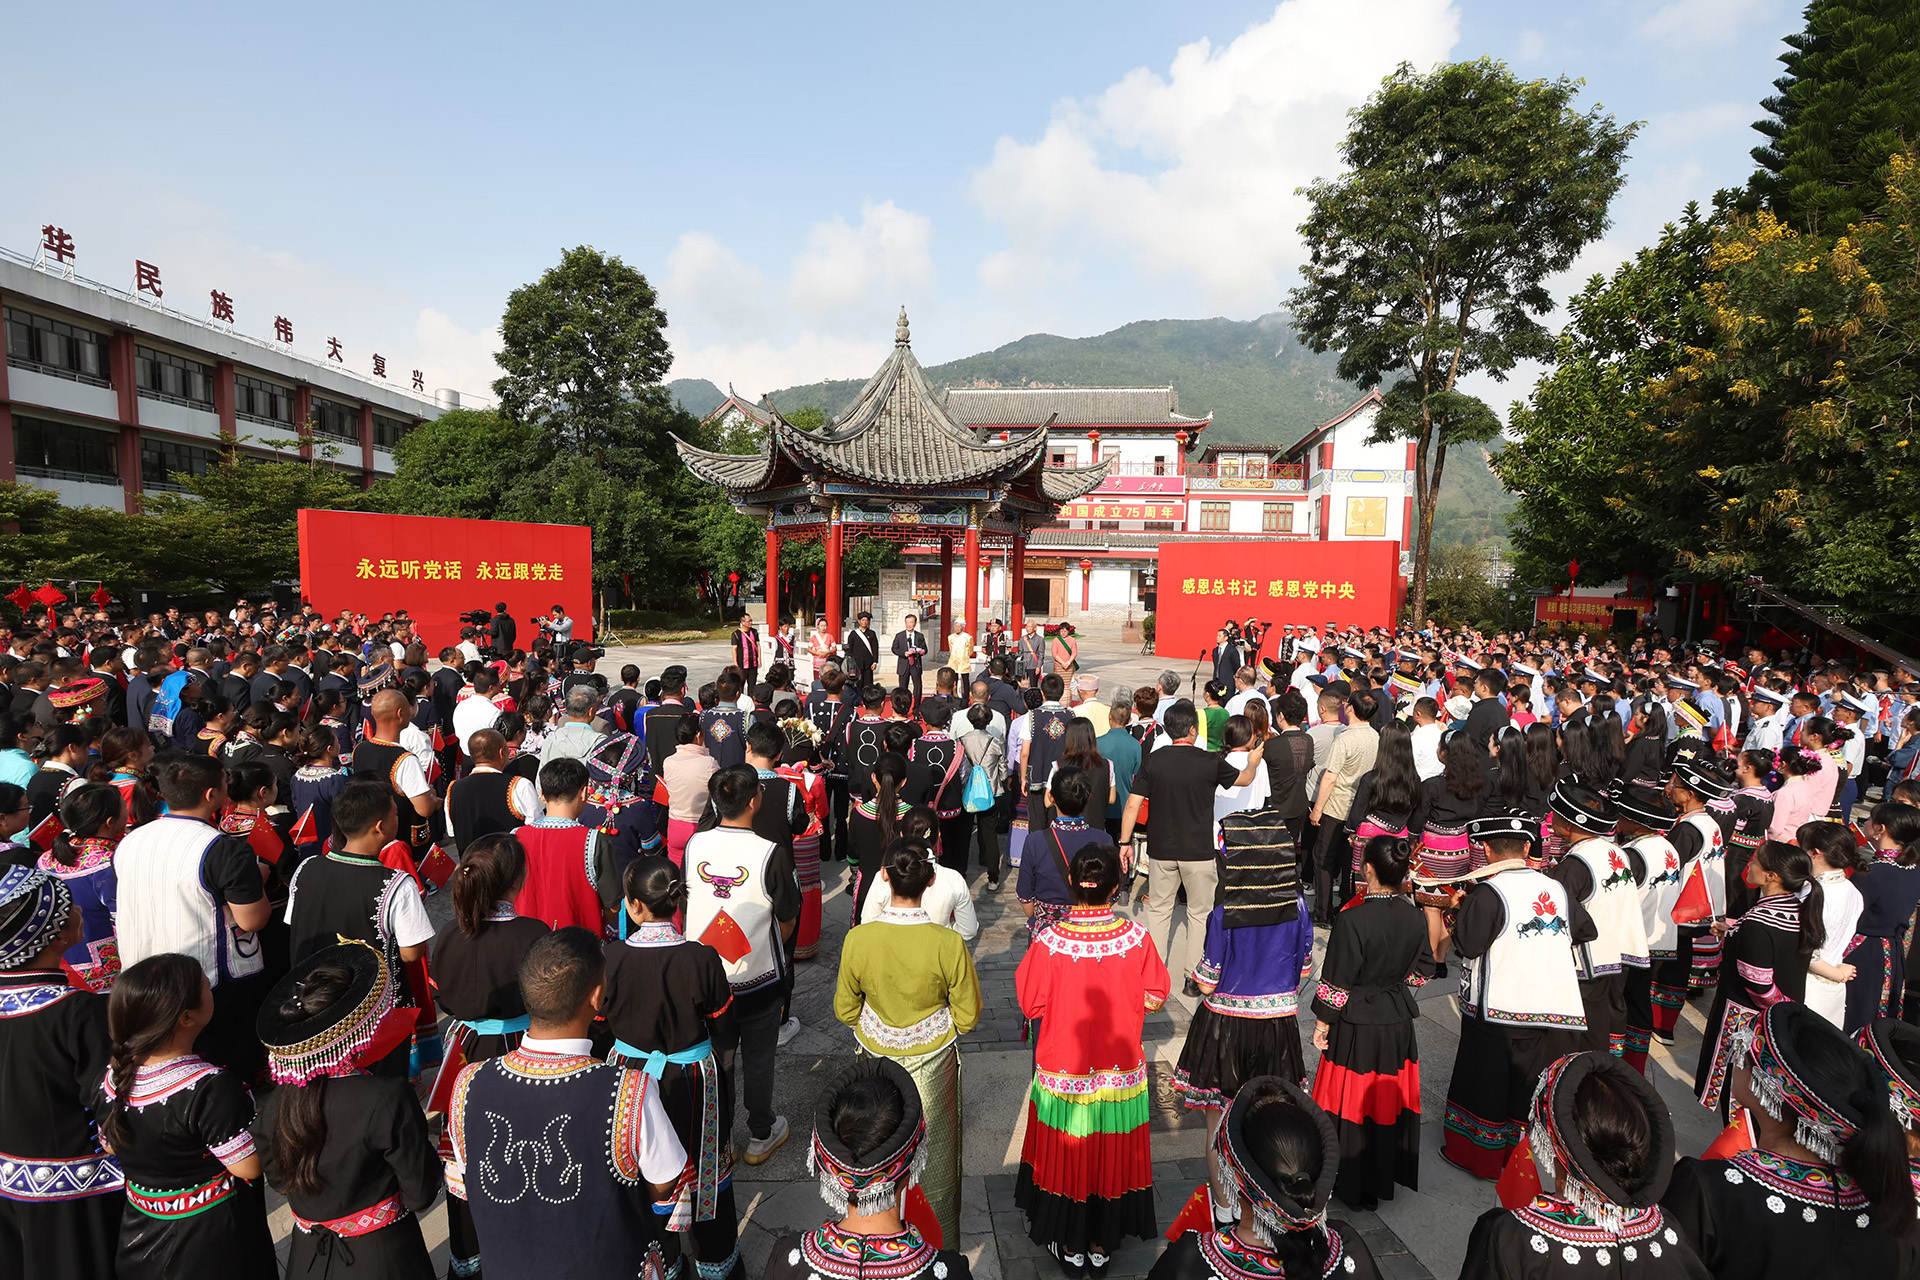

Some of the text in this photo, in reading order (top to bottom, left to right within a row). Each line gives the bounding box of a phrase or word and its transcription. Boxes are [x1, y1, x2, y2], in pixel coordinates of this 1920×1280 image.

[42, 224, 424, 391] 华民族伟大复兴
[1061, 504, 1174, 519] 和国成立75周年
[356, 558, 564, 581] 永远听党话 永远跟党走
[1182, 577, 1355, 600] 感恩总书记 感恩党中央
